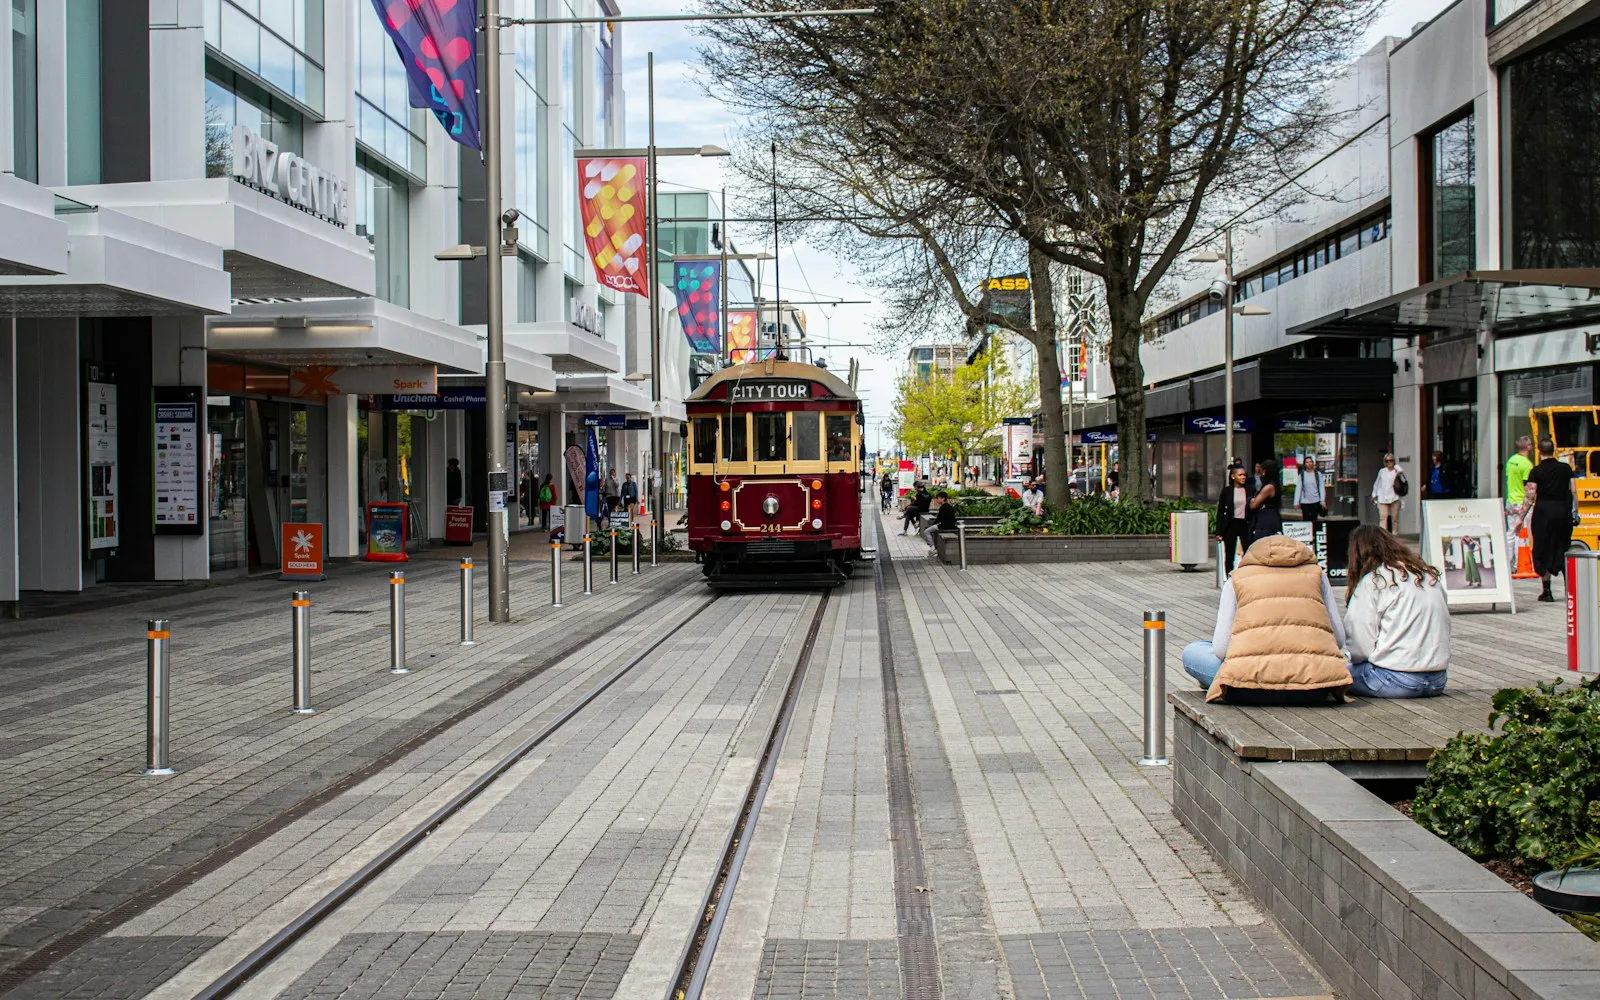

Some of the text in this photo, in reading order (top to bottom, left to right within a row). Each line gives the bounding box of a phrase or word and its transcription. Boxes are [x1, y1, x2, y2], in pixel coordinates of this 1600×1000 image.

[232, 125, 348, 226] BNZ CENTRE
[988, 278, 1029, 290] ASB
[393, 379, 424, 390] Spark
[732, 385, 807, 398] CITY TOUR
[393, 394, 437, 402] Unichem
[584, 418, 599, 426] bnz
[760, 524, 781, 532] 244
[1567, 592, 1575, 636] Litter
